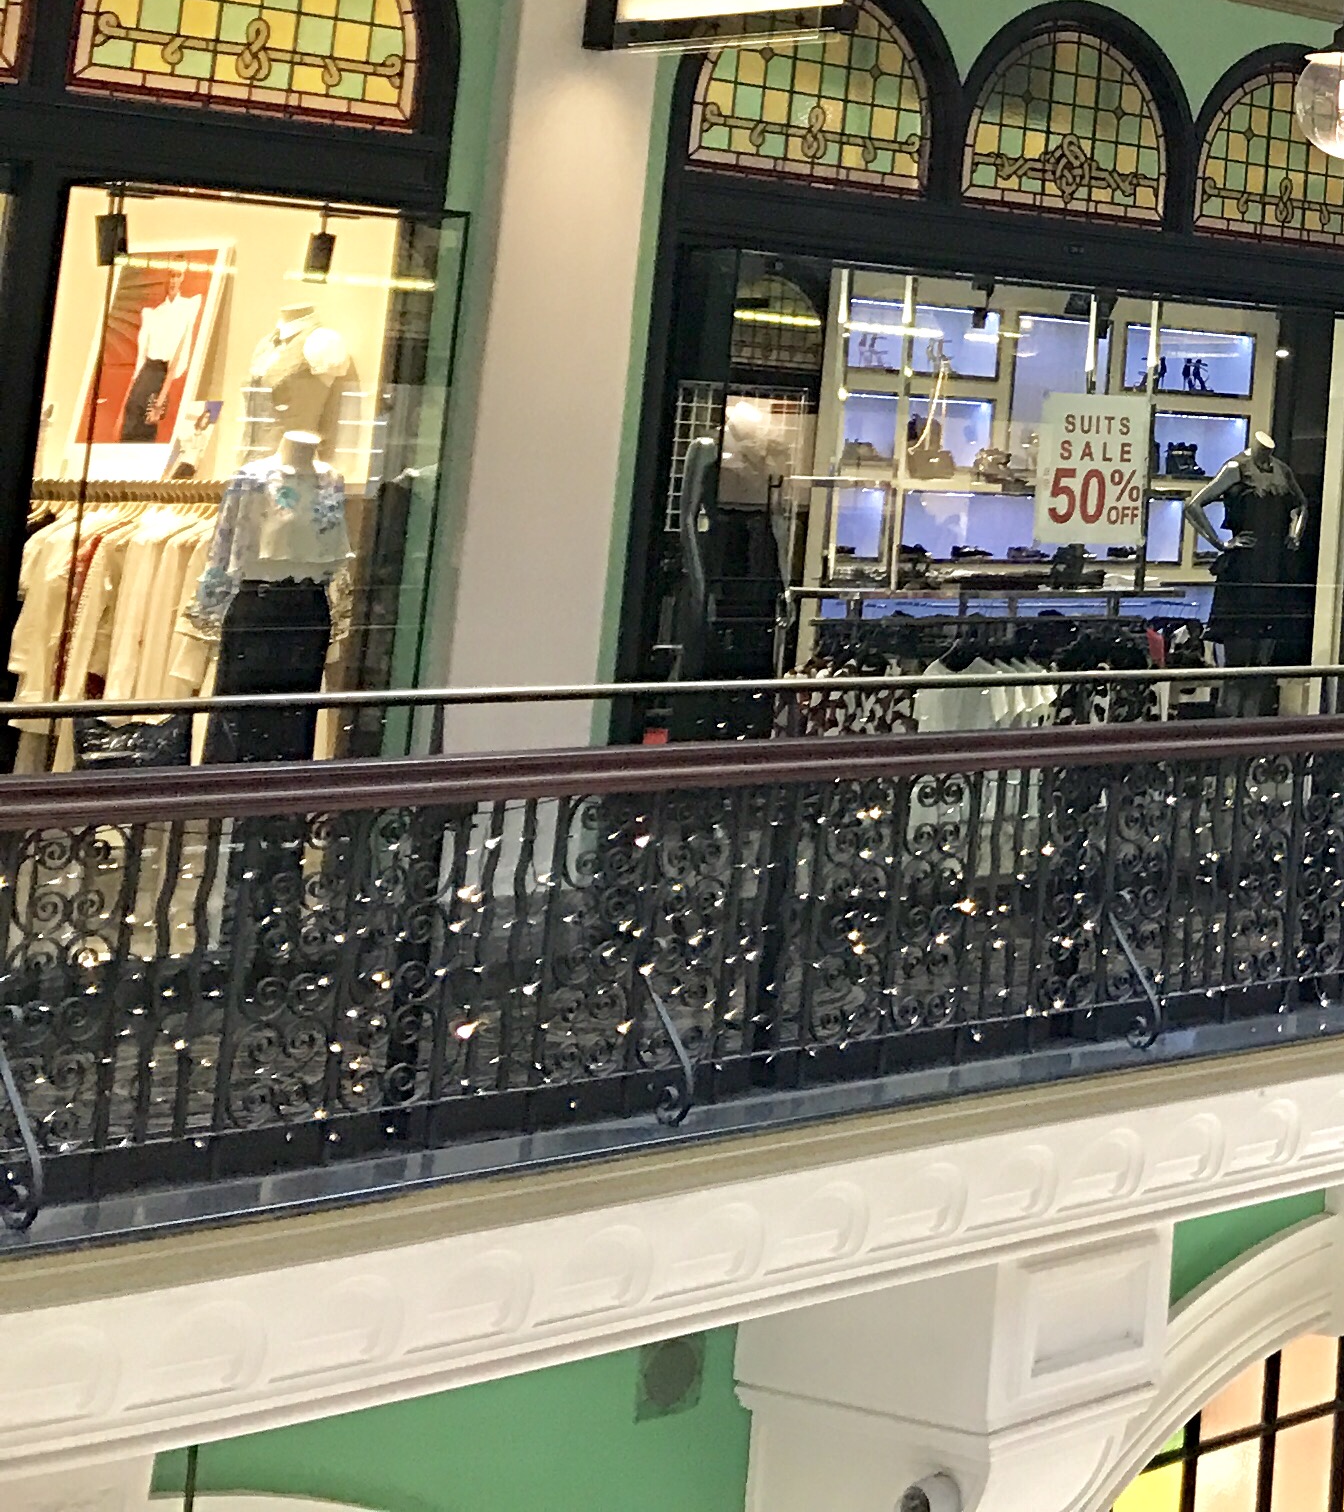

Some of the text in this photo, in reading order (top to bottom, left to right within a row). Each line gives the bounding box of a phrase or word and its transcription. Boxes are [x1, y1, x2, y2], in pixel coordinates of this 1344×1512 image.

[1064, 414, 1131, 435] SUITS
[1060, 440, 1132, 463] SALE
[1048, 468, 1140, 524] 50%
[1106, 506, 1139, 525] OFF
